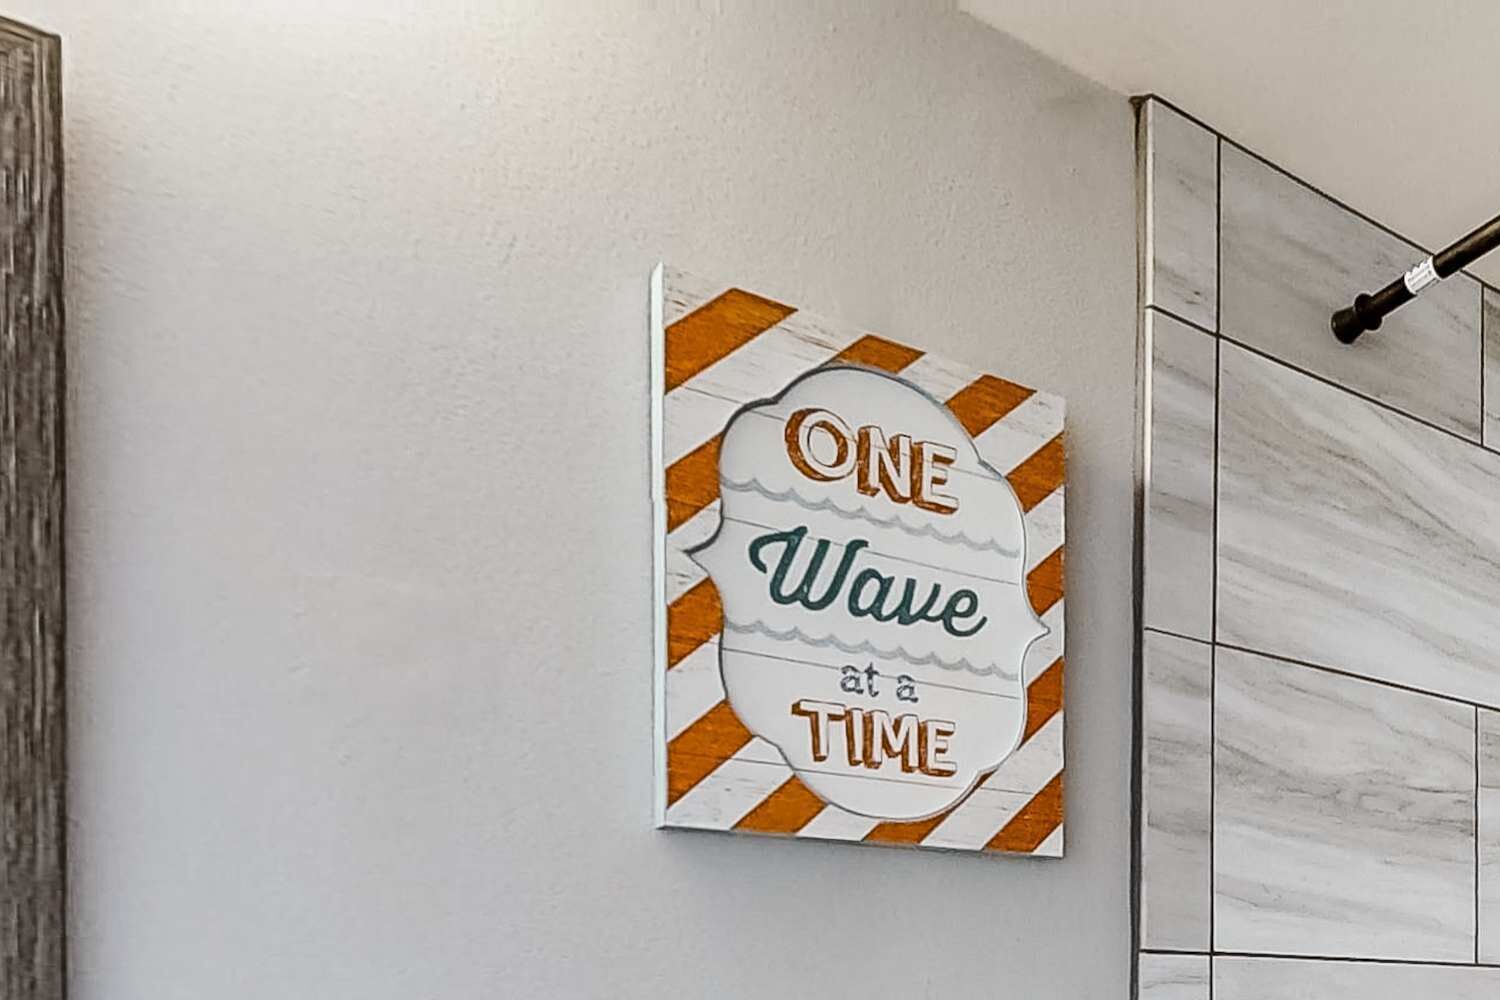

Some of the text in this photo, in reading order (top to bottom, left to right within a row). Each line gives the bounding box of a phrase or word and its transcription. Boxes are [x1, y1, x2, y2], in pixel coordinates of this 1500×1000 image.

[785, 408, 958, 514] ONE
[749, 526, 987, 637] Wave
[840, 662, 919, 702] at a
[791, 699, 957, 777] TIME
